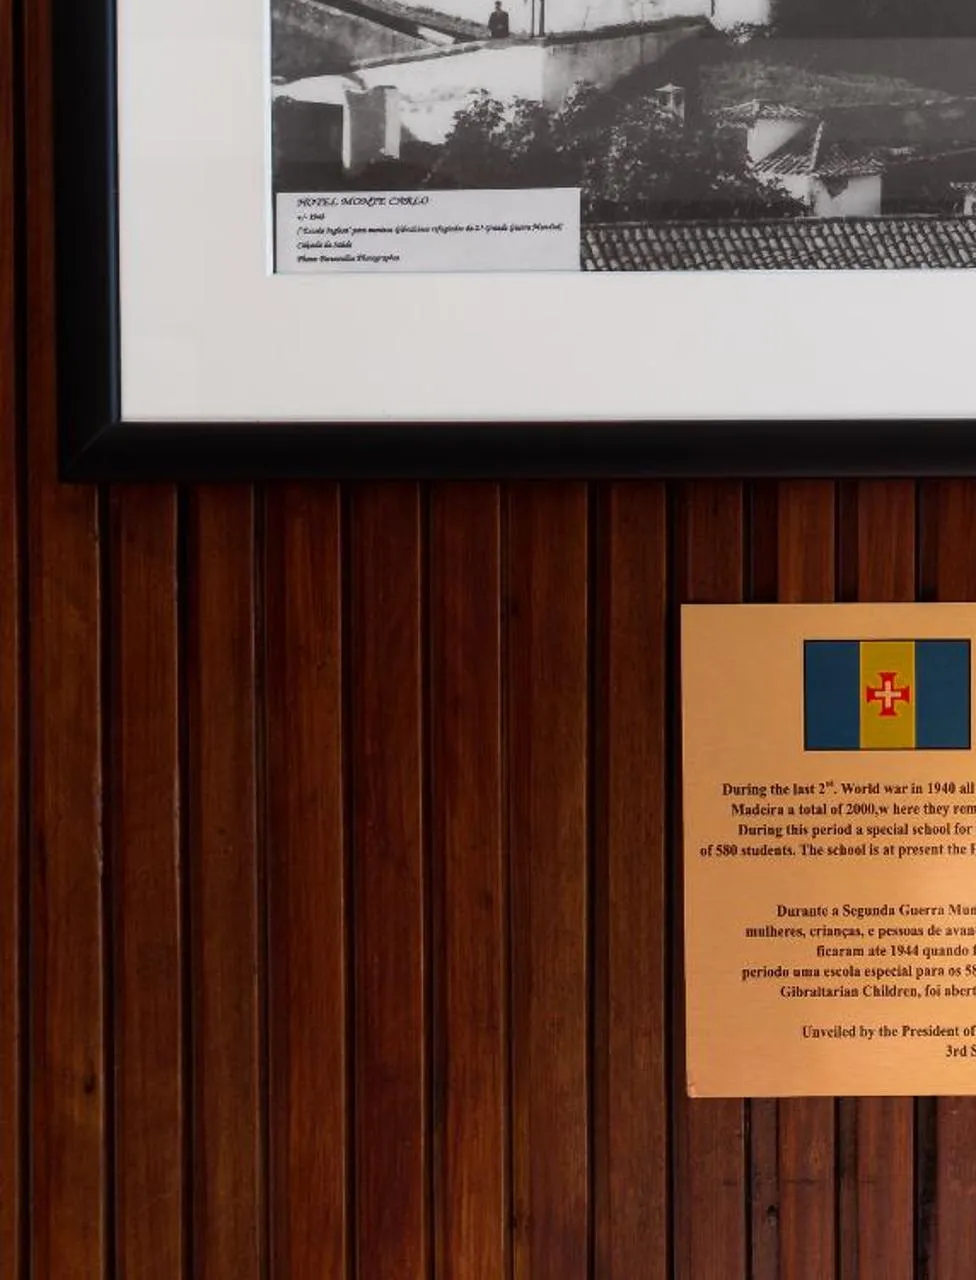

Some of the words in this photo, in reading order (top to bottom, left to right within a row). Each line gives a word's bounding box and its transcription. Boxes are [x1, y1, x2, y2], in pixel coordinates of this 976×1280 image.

[722, 783, 767, 797] During
[770, 783, 790, 795] the
[792, 783, 814, 795] last
[840, 782, 879, 794] World
[883, 785, 908, 794] war
[910, 782, 923, 794] in
[928, 781, 956, 794] 1940
[959, 781, 974, 794] all
[731, 803, 783, 816] Madeira
[787, 806, 795, 815] a
[798, 803, 826, 815] total
[830, 802, 843, 815] of
[893, 802, 920, 814] here
[923, 802, 949, 817] they
[738, 824, 783, 838] During
[786, 824, 808, 835] this
[811, 823, 852, 838] period
[855, 826, 863, 835] a
[866, 822, 908, 838] special
[912, 822, 950, 835] school
[954, 822, 972, 834] for
[699, 844, 713, 856] of
[715, 844, 737, 857] 580
[741, 844, 795, 856] students.
[800, 843, 824, 856] The
[827, 843, 866, 855] school
[869, 843, 879, 855] is
[883, 845, 894, 855] at
[898, 844, 943, 858] present
[947, 843, 966, 855] the
[776, 904, 828, 917] Durante
[831, 907, 838, 916] a
[842, 904, 895, 919] Segunda
[898, 904, 944, 915] Guerra
[867, 928, 874, 936] e
[878, 928, 923, 939] pessoas
[927, 924, 942, 936] de
[816, 945, 864, 957] ficaram
[890, 940, 918, 956] 1944
[922, 944, 969, 958] quando
[792, 968, 820, 977] uma
[823, 965, 860, 977] escola
[864, 965, 912, 980] especial
[915, 967, 944, 979] para
[948, 967, 961, 977] os
[779, 983, 859, 997] Gibraltarian
[862, 984, 921, 998] Children,
[924, 984, 941, 997] foi
[802, 1025, 856, 1038] Unveiled
[859, 1025, 874, 1040] by
[878, 1025, 898, 1037] the
[901, 1024, 959, 1036] President
[963, 1024, 976, 1036] of
[945, 1044, 967, 1057] 3rd
